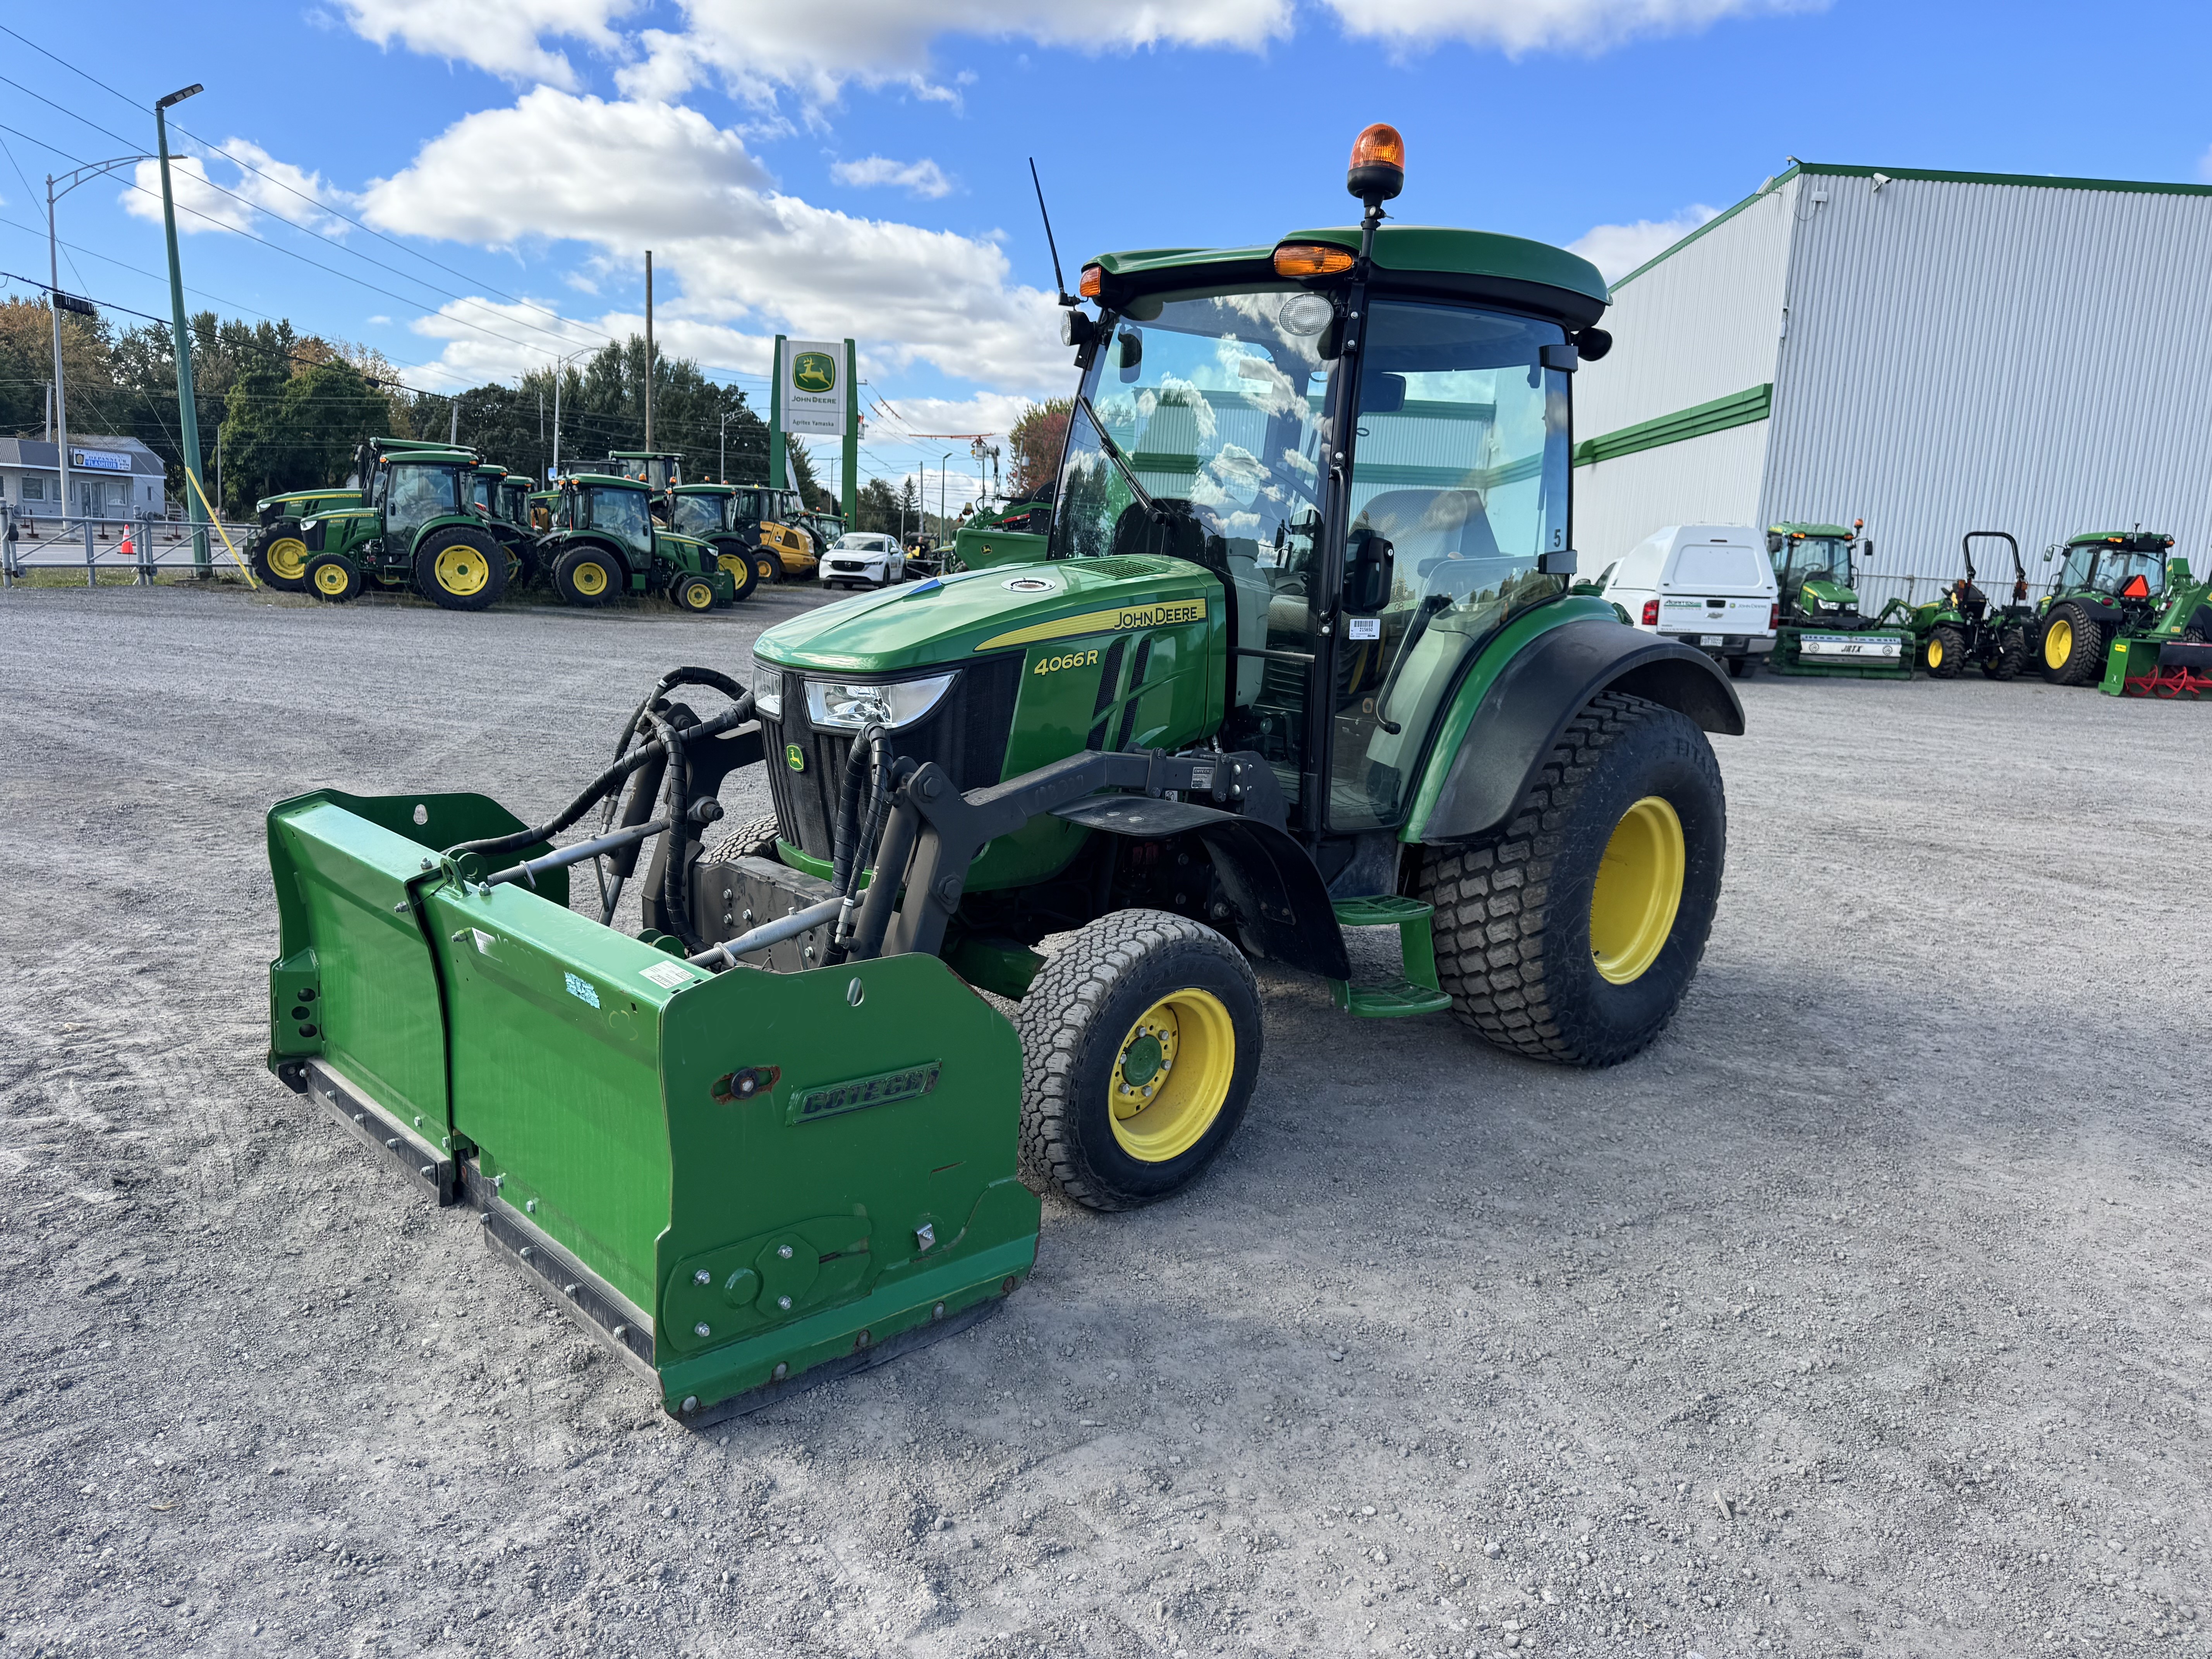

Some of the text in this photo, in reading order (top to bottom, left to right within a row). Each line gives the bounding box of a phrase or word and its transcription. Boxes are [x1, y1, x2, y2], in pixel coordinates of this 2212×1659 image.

[1554, 529, 1561, 548] 5
[1114, 606, 1198, 629] JOHN DEERE
[802, 1069, 924, 1114] COTECH
